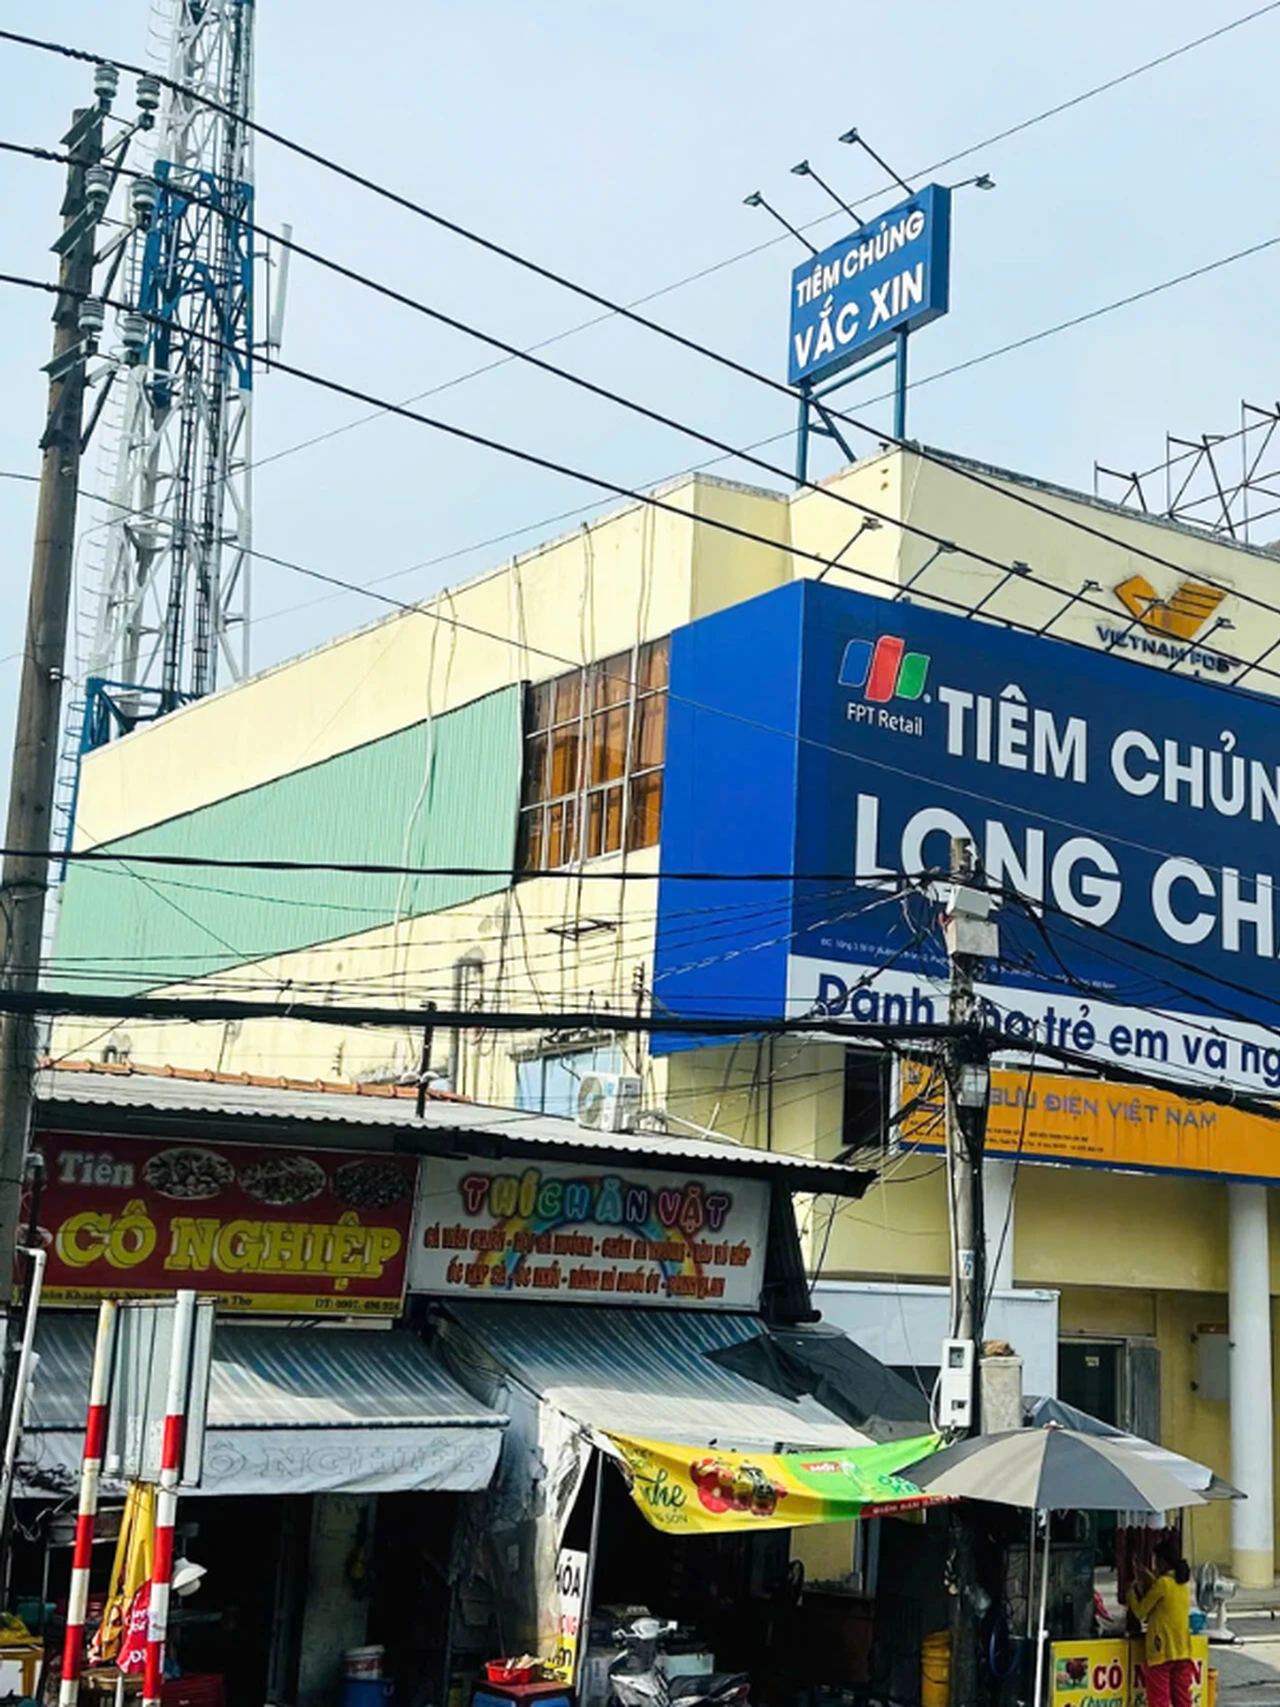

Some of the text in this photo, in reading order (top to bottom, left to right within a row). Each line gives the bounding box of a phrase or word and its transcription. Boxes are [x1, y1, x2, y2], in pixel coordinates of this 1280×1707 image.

[796, 260, 840, 308] TIÊM
[795, 263, 923, 369] VẮC XIN
[1097, 626, 1185, 661] VIETNAM
[847, 702, 922, 736] FPT Retail
[939, 683, 1087, 783] TIÊM
[855, 794, 1122, 927] LONG
[1044, 1004, 1095, 1050] trẻ
[1110, 1024, 1168, 1062] em
[1044, 1088, 1098, 1120] ĐIỆN
[1107, 1098, 1159, 1127] VIỆT
[1166, 1107, 1217, 1129] NAM
[58, 1150, 135, 1187] Tiên
[657, 1183, 731, 1232] VẶT
[55, 1199, 401, 1291] CÔ NGHIỆP
